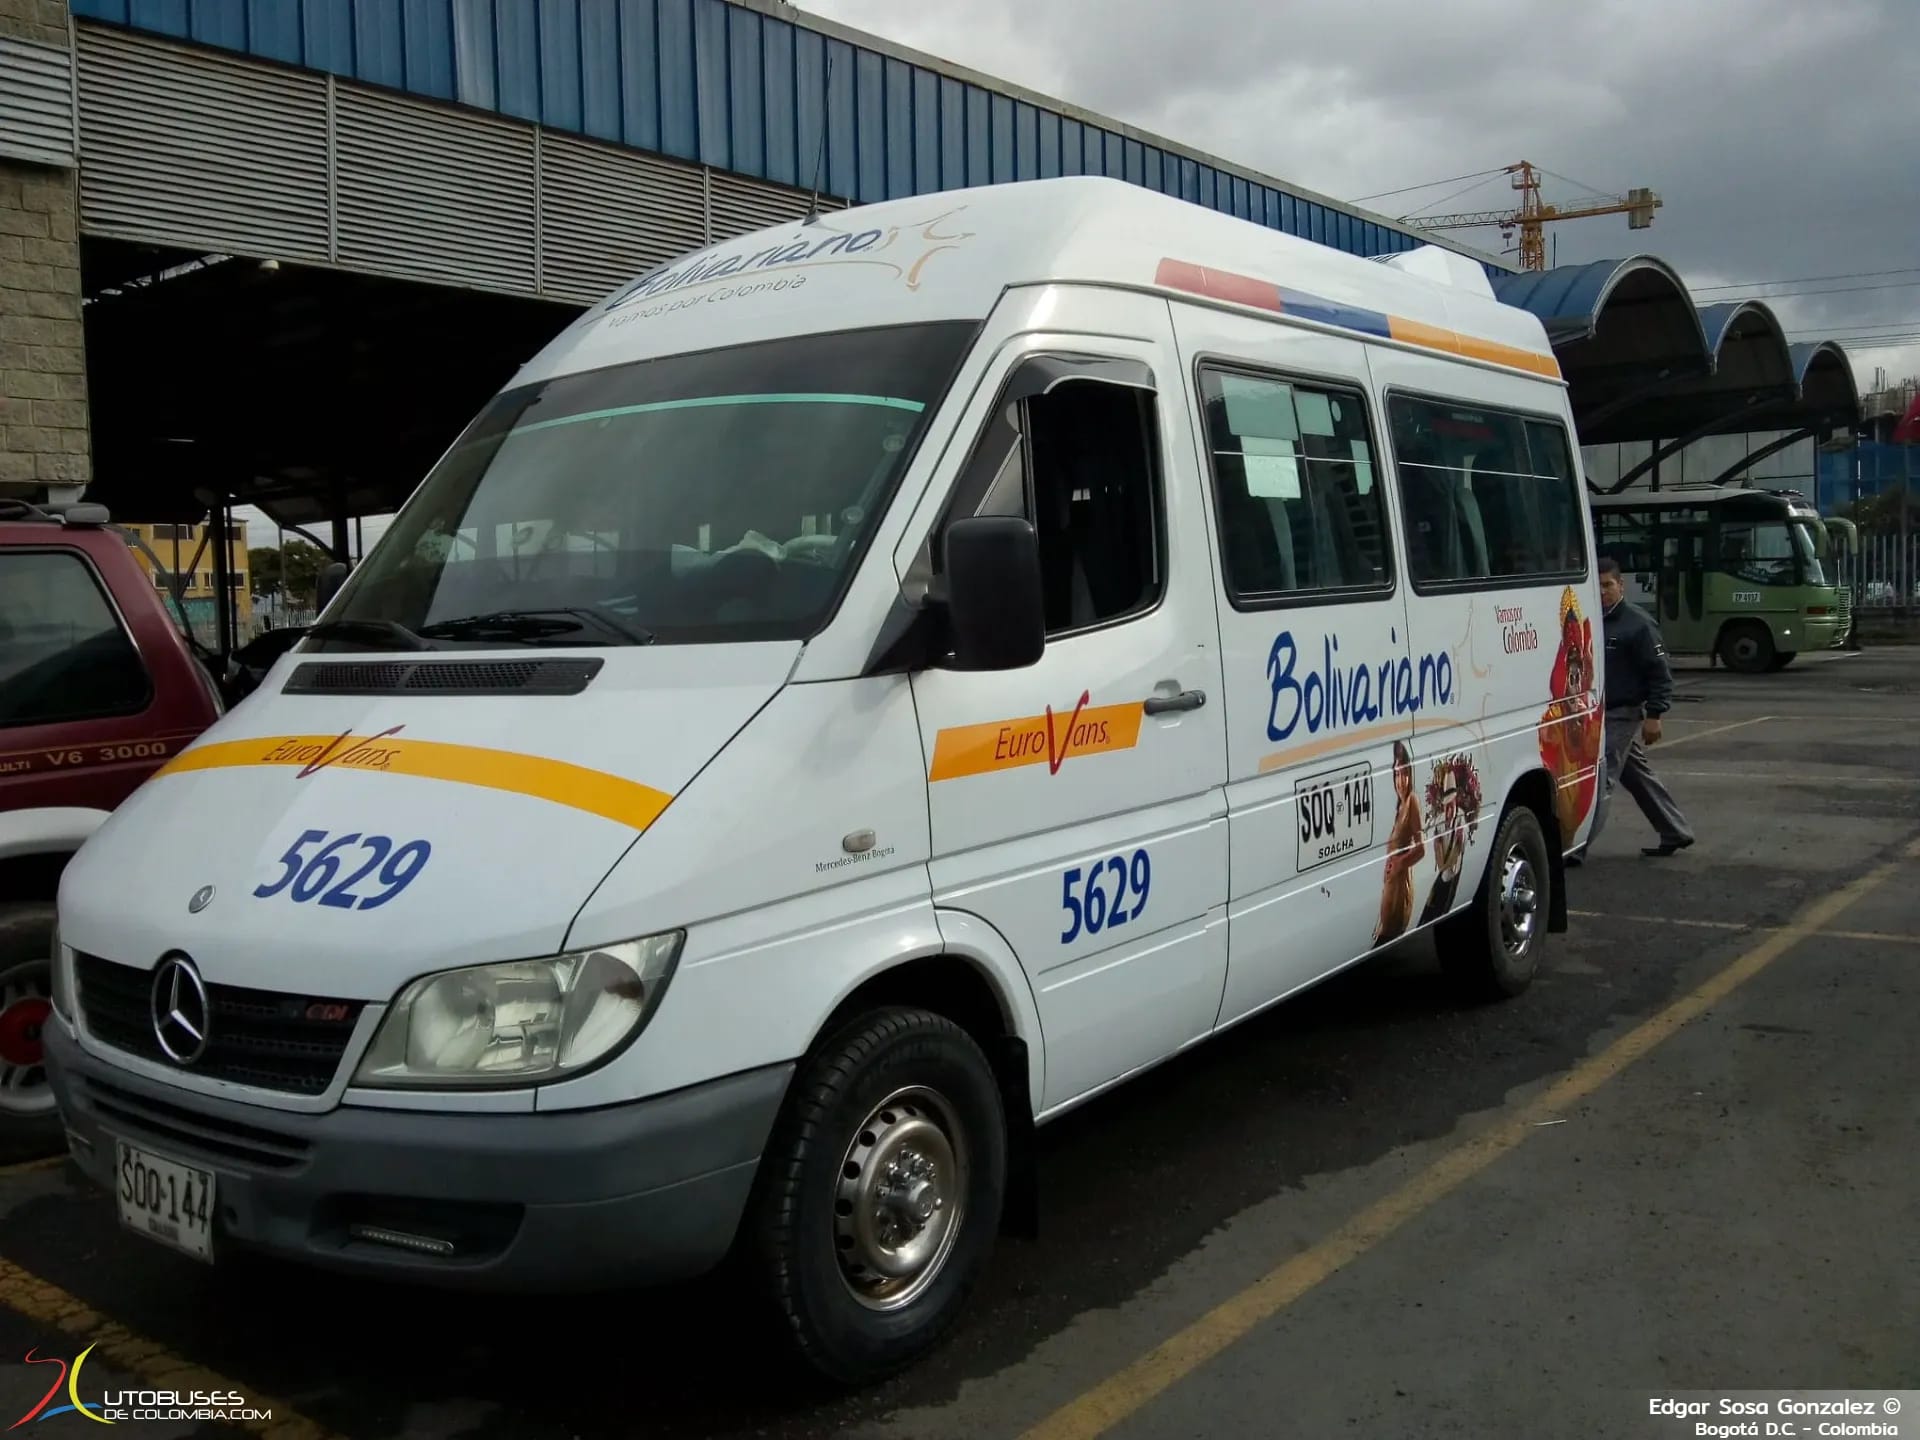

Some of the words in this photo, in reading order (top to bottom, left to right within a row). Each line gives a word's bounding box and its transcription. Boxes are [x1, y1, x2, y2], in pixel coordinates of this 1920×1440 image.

[604, 228, 883, 312] Bolivariano
[665, 293, 709, 317] por
[707, 273, 808, 303] Colombia
[1502, 622, 1538, 655] Colombia
[1265, 626, 1453, 743] Bolivariano
[46, 751, 84, 765] V6
[100, 742, 167, 761] 3000
[252, 829, 432, 911] 5629
[815, 852, 871, 873] Mercedes-Benz
[1318, 838, 1354, 859] SOACHA
[1060, 849, 1151, 945] 5629
